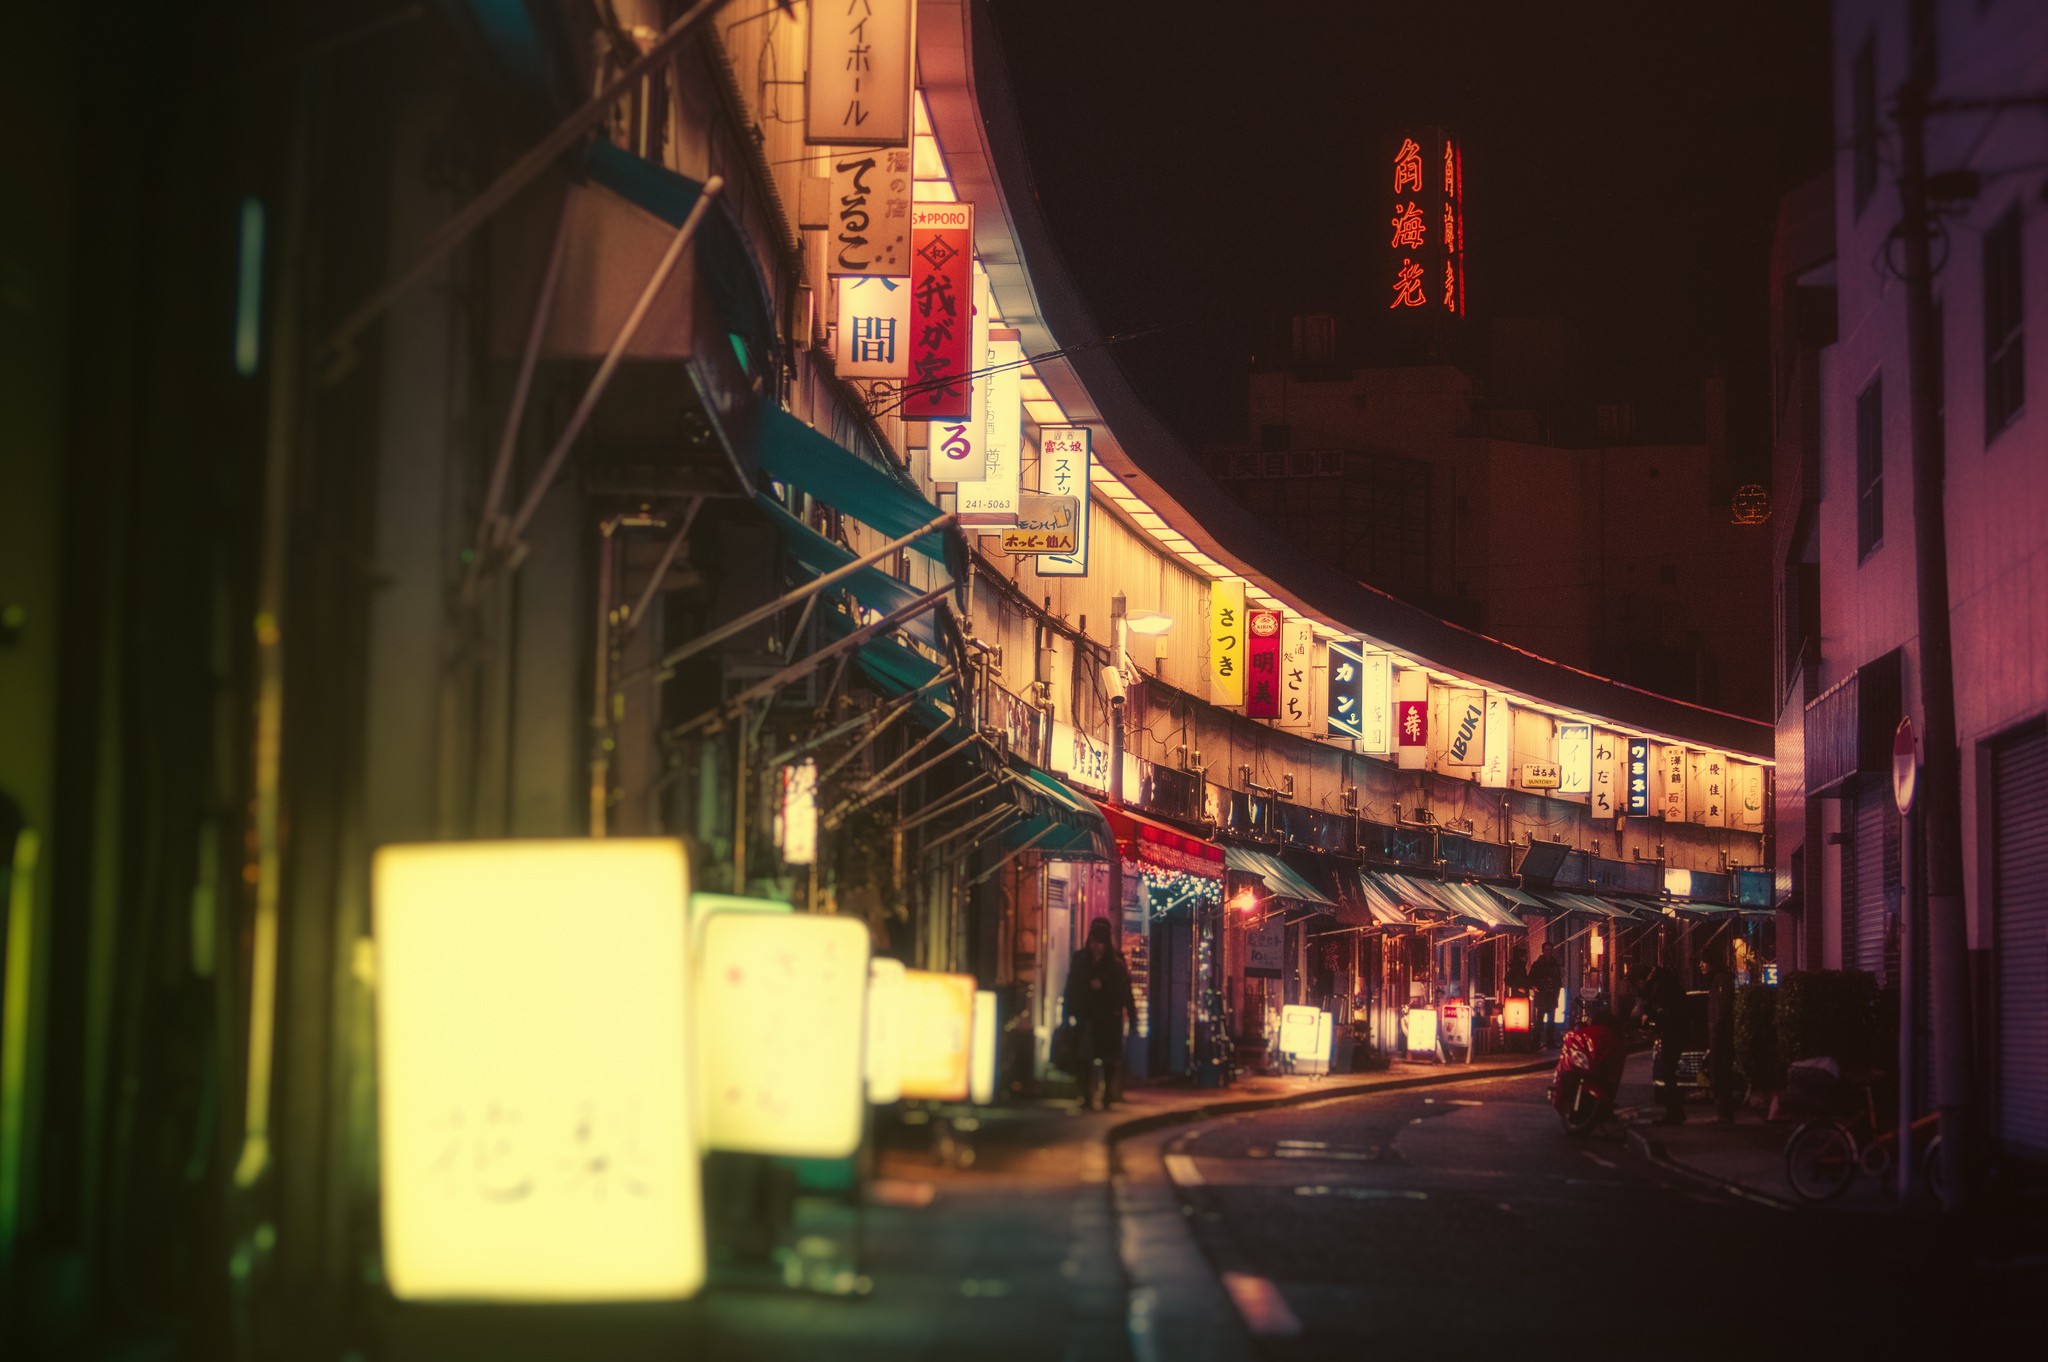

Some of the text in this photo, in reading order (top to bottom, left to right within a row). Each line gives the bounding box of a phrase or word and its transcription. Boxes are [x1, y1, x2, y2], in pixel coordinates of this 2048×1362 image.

[836, 157, 876, 270] てるこ
[1391, 138, 1426, 309] 角海老
[914, 274, 962, 406] 我が家
[1044, 440, 1083, 453] 富久娘
[965, 499, 1011, 510] 241-5063
[1217, 608, 1236, 677] さつき
[1253, 651, 1274, 705] 明美
[1287, 668, 1303, 720] さち
[1450, 704, 1482, 761] IBUKI
[1596, 744, 1611, 811] わだち
[1631, 745, 1645, 808] ウミネコ
[1667, 793, 1681, 818] 百合
